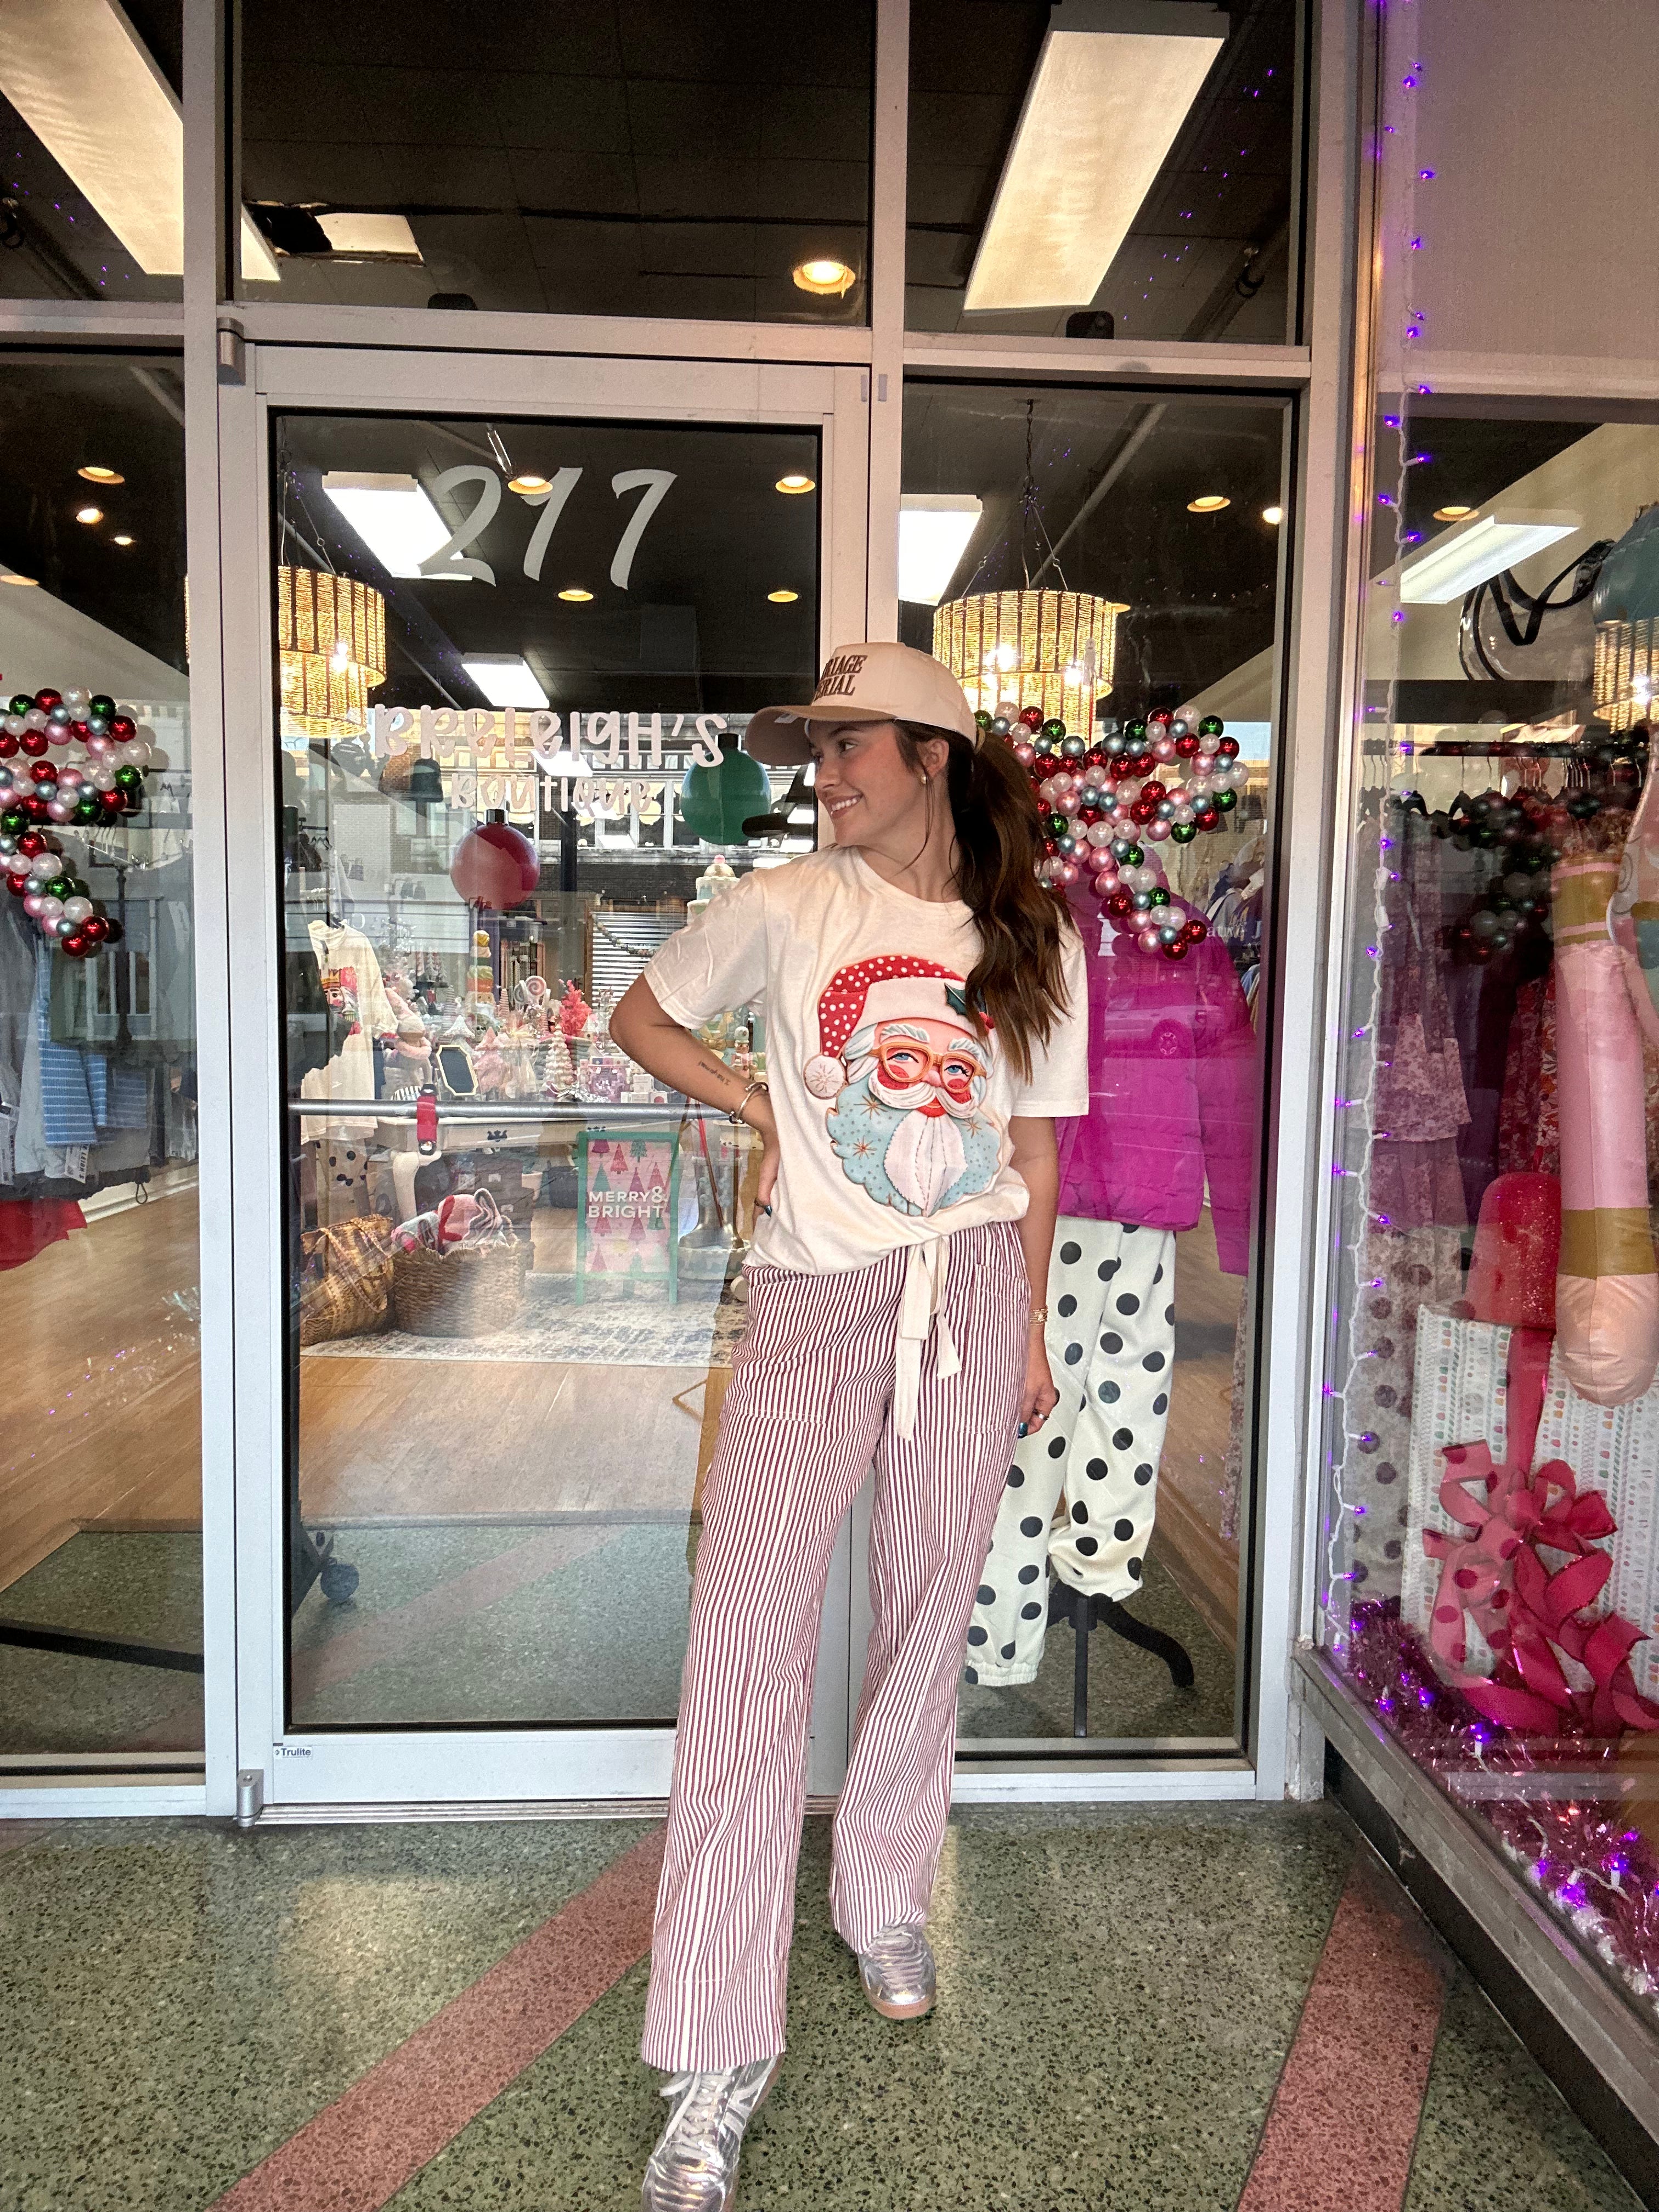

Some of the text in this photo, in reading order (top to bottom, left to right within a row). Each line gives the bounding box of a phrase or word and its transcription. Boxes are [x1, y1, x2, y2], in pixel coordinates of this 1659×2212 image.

[419, 465, 678, 590] 217
[588, 1205, 664, 1218] BRIGHT
[281, 1748, 312, 1756] Trulite
